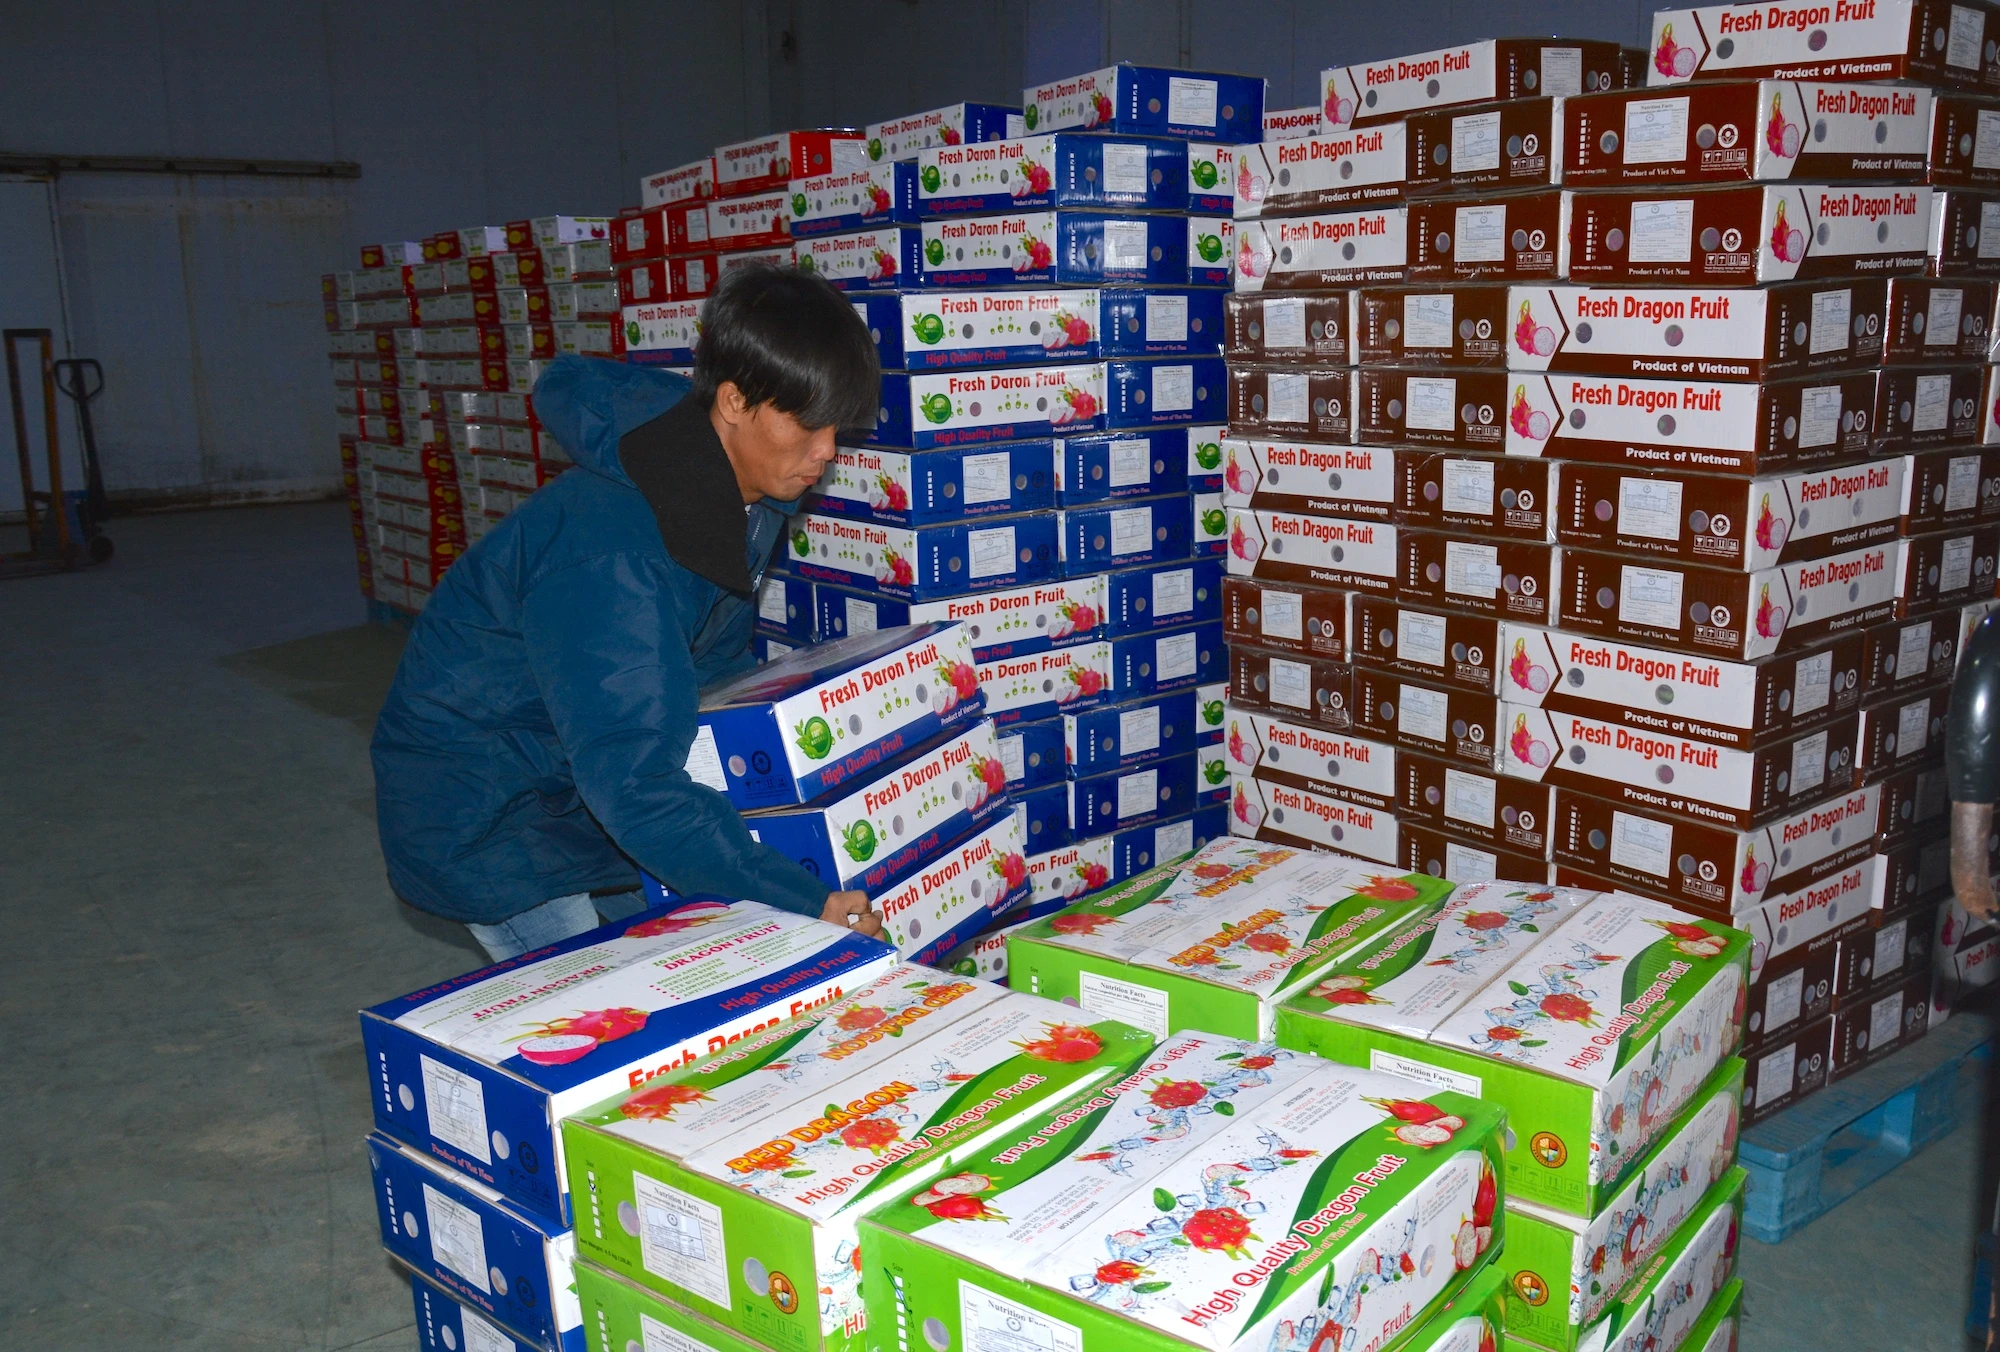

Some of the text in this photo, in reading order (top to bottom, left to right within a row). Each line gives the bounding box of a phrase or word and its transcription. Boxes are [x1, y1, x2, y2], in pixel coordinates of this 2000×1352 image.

[1721, 0, 1875, 34] Fresh Dragon Fruit
[1367, 51, 1470, 85] Fresh Dragon Fruit
[1774, 62, 1892, 79] Product of Vietnam
[1037, 77, 1095, 102] Fresh Daron Fruit
[1817, 90, 1915, 120] Fresh Dragon Fruit
[939, 144, 1023, 165] Fresh Daron Fruit
[1279, 132, 1383, 163] Fresh Dragon Fruit
[1319, 188, 1399, 203] Product of Vietnam
[1820, 194, 1916, 220] Fresh Dragon Fruit
[942, 220, 1026, 238] Fresh Daron Fruit
[941, 296, 1059, 315] Fresh Daron Fruit
[1578, 296, 1729, 323] Fresh Dragon Fruit
[1633, 361, 1749, 374] Product of Vietnam
[949, 373, 1066, 394] Fresh Daron Fruit
[1572, 383, 1721, 413] Fresh Dragon Fruit
[934, 428, 1014, 443] High Quality Fruit
[1268, 447, 1371, 472] Fresh Dragon Fruit
[1626, 448, 1740, 466] Product of Vietnam
[1801, 466, 1888, 502] Fresh Dragon Fruit
[1272, 517, 1373, 544] Fresh Dragon Fruit
[948, 588, 1065, 619] Fresh Daron Fruit
[819, 644, 939, 713] Fresh Daron Fruit
[1570, 643, 1720, 687] Fresh Dragon Fruit
[1624, 712, 1738, 742] Product of Vietnam
[1269, 726, 1370, 763] Fresh Dragon Fruit
[1571, 721, 1718, 768] Fresh Dragon Fruit
[821, 734, 904, 786] High Quality Fruit
[864, 742, 972, 816] Fresh Daron Fruit
[881, 839, 991, 923] Fresh Daron Fruit
[663, 924, 782, 971] DRAGON FRUIT
[719, 951, 860, 1011] High Quality Fruit
[1101, 982, 1146, 998] Nutrition Facts
[819, 983, 977, 1060] RED DRAGON
[1565, 1045, 1603, 1070] High
[1591, 1014, 1641, 1047] Quality
[1624, 980, 1666, 1015] Dragon
[1658, 961, 1692, 984] Fruit
[1397, 1063, 1453, 1084] Nutrition Facts
[726, 1140, 795, 1173] RED
[789, 1081, 918, 1143] DRAGON
[795, 1073, 1046, 1204] High Quality Dragon Fruit
[1182, 1288, 1241, 1326] High
[1233, 1235, 1310, 1286] Quality
[1296, 1185, 1368, 1237] Dragon
[1356, 1154, 1406, 1187] Fruit
